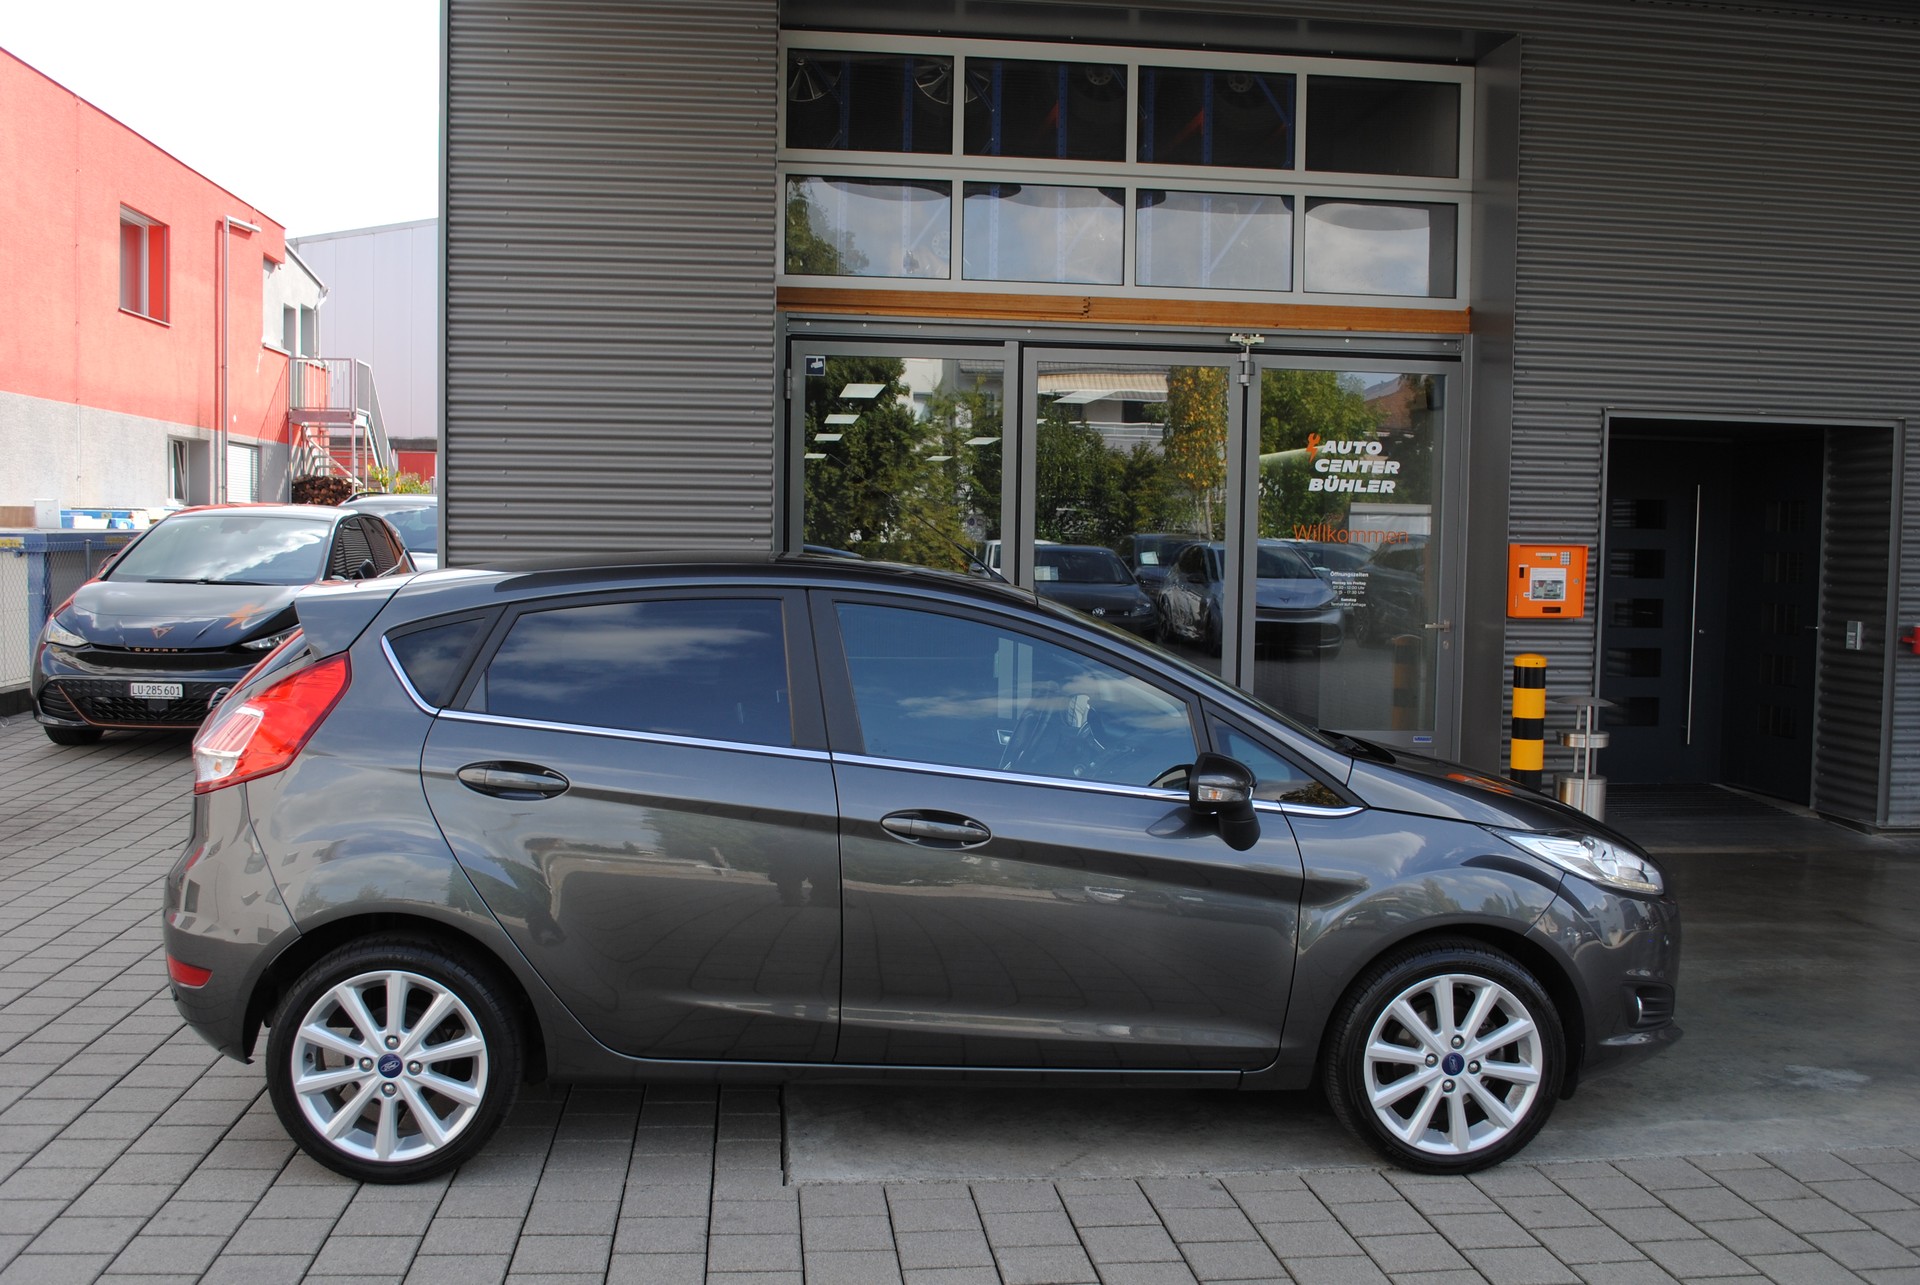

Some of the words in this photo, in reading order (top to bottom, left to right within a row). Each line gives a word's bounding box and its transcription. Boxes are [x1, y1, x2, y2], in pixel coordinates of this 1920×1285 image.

[1322, 440, 1383, 456] AUTO
[1314, 458, 1400, 474] CENTER
[1308, 475, 1396, 494] BÜHLER
[1293, 524, 1409, 543] Willkommen
[1329, 570, 1369, 578] Öffnungszeiten
